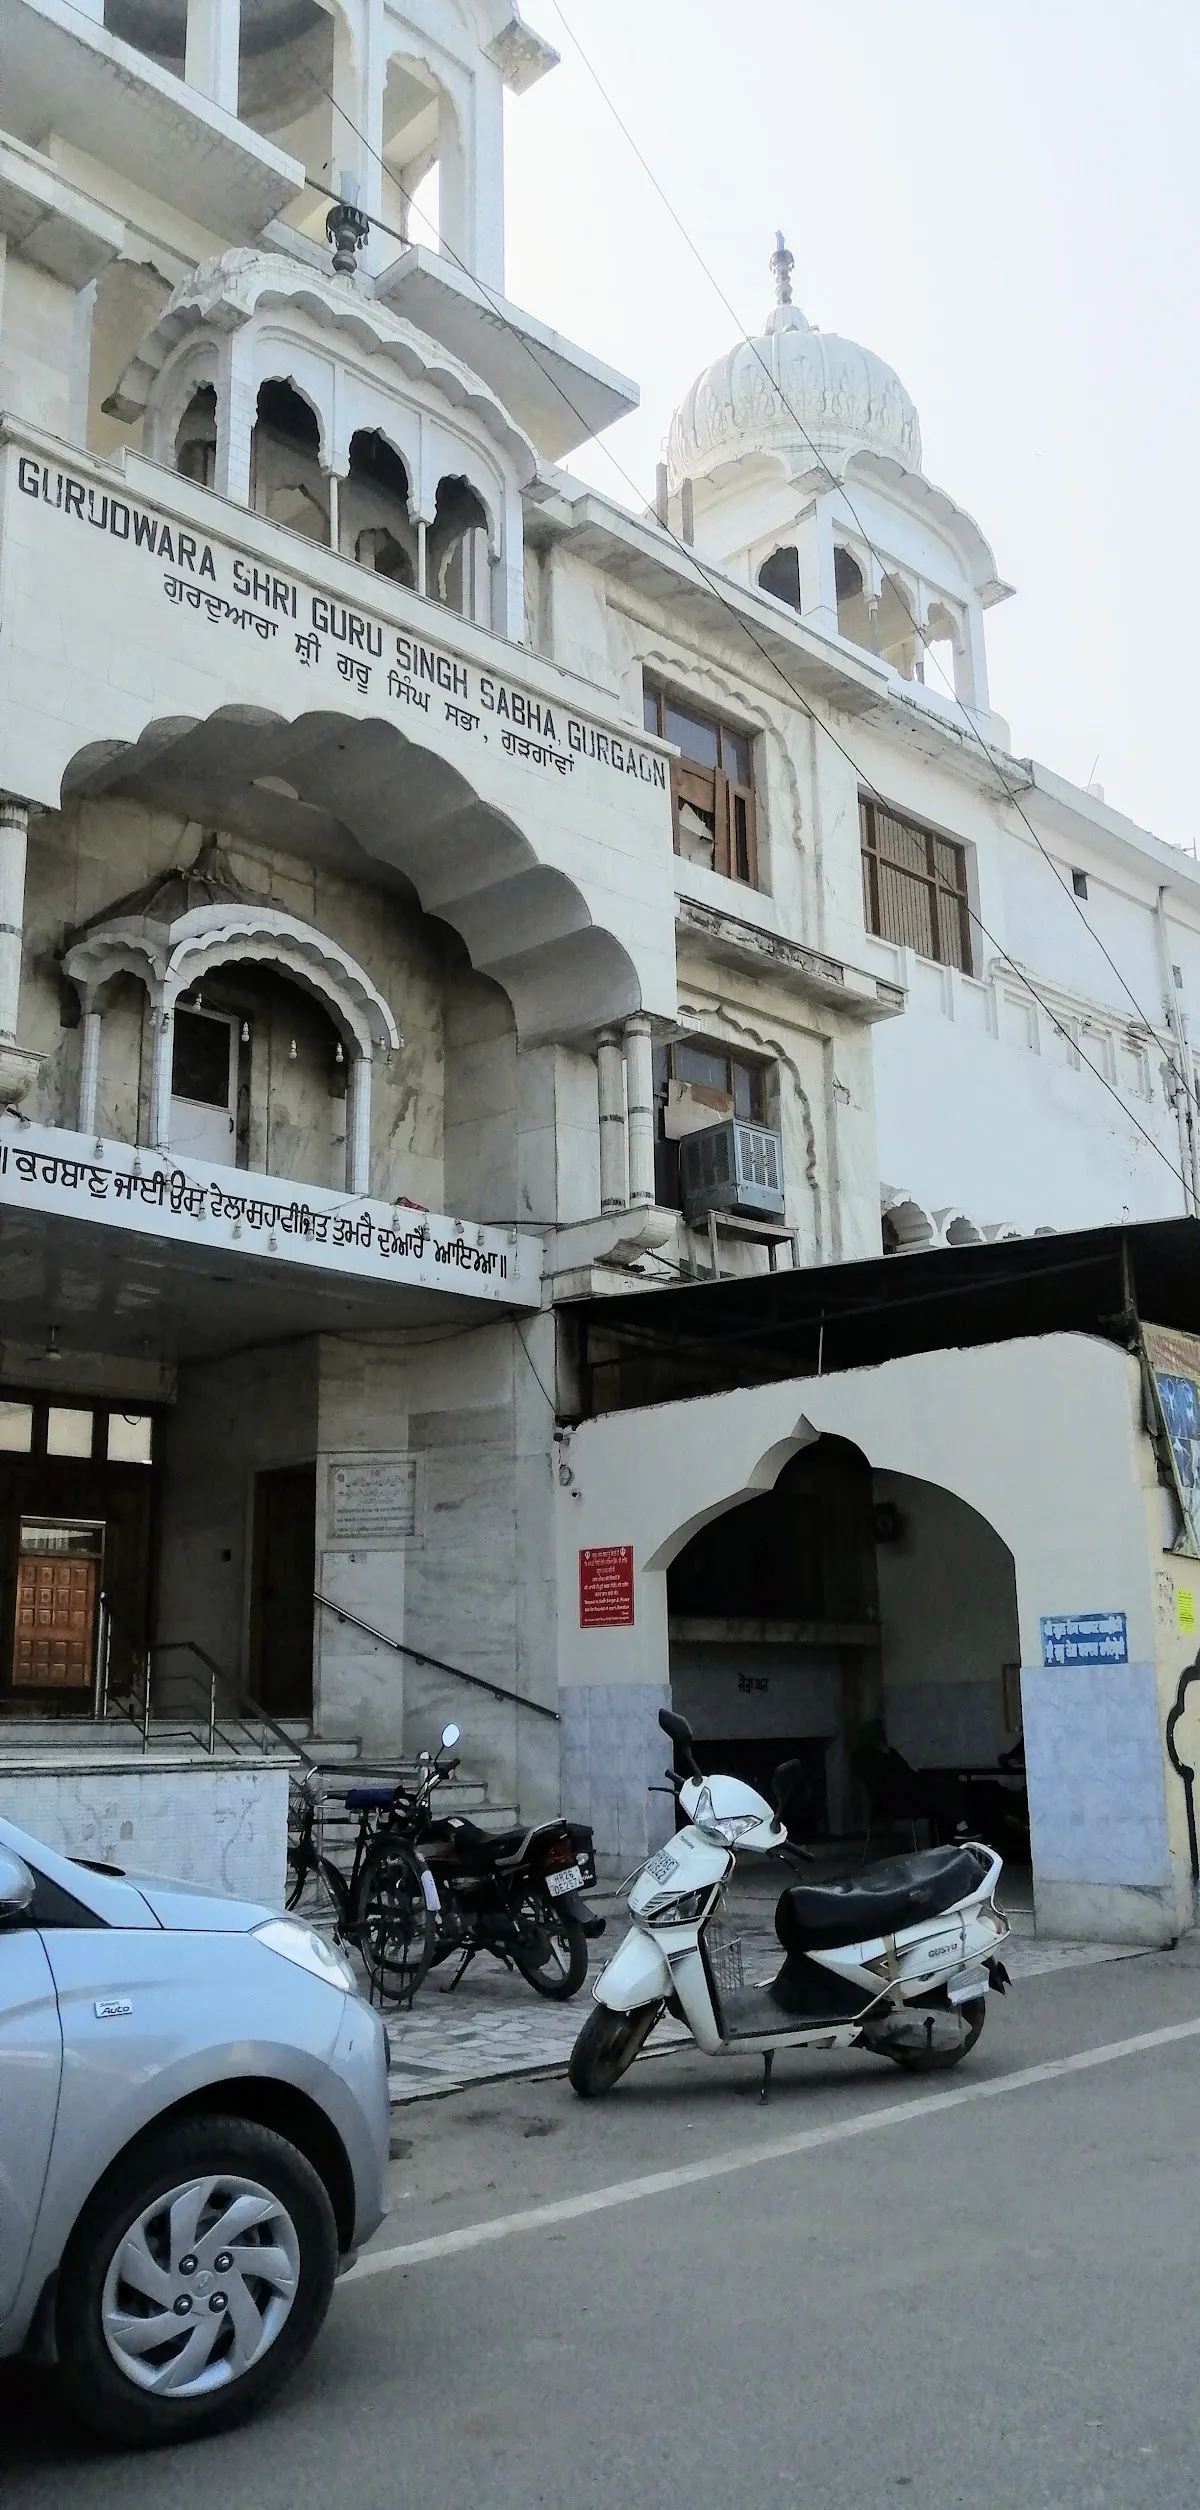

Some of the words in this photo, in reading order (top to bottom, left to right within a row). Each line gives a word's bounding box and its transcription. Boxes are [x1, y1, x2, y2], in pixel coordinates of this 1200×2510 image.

[19, 457, 217, 581] GURUDWARA
[233, 559, 297, 619] SHRI
[312, 597, 383, 657] GURU
[396, 637, 469, 699] SINGH
[567, 719, 667, 790] GURGAON
[163, 573, 279, 640] ਗੁਰਦੁਆਰਾ
[336, 651, 373, 695] ਗੁਰੂ
[386, 669, 431, 713] ਸਿੰਘ
[12, 1148, 113, 1199] ਕੁਰਬਾਣੁ
[115, 1170, 167, 1206] ਜਾਈ
[210, 1182, 248, 1221] ਵੇਲਾ
[927, 1942, 958, 1959] GUSTO
